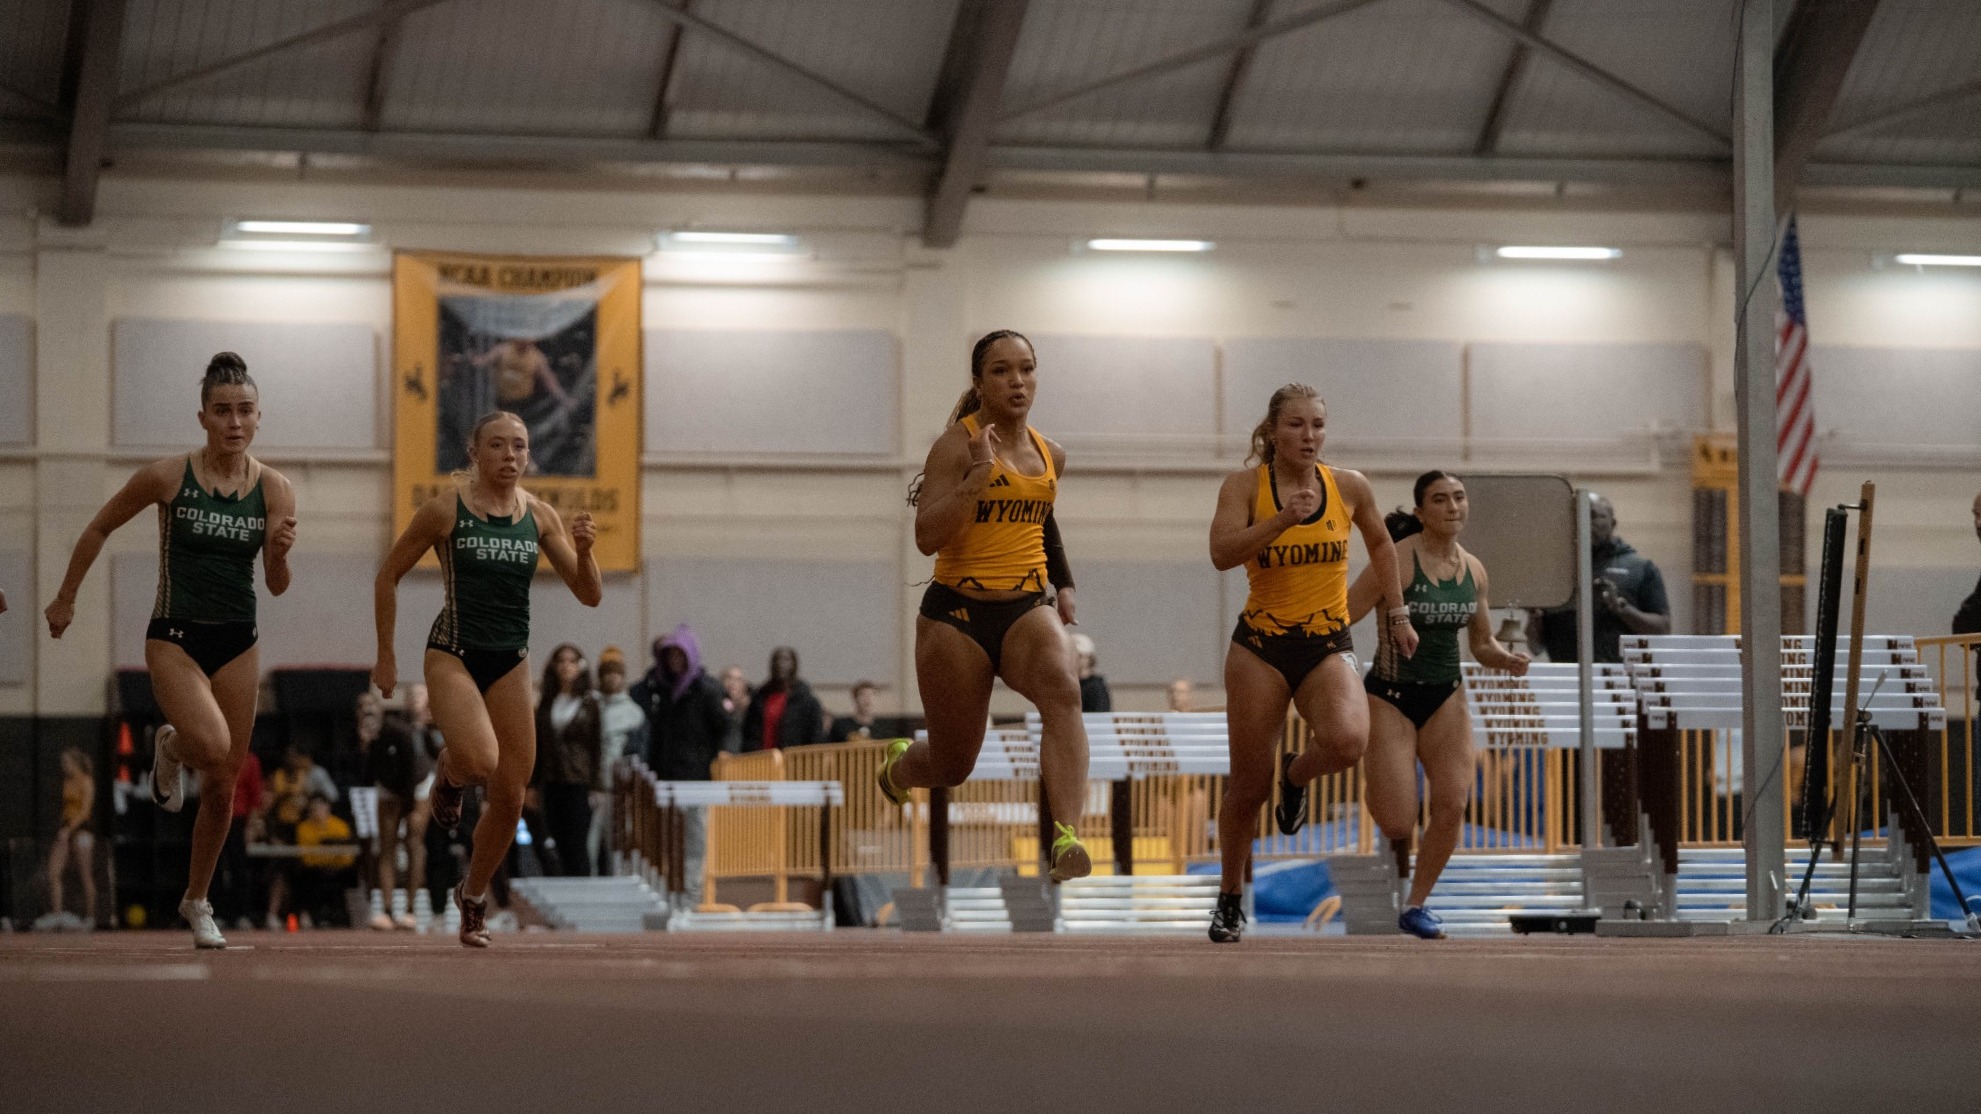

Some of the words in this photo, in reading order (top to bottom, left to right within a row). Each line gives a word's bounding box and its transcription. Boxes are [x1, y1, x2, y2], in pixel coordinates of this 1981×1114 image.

[176, 506, 265, 530] COLORADO
[192, 521, 250, 542] STATE
[476, 548, 529, 564] STATE
[1424, 613, 1470, 625] STATE
[1488, 732, 1549, 745] WYOMING
